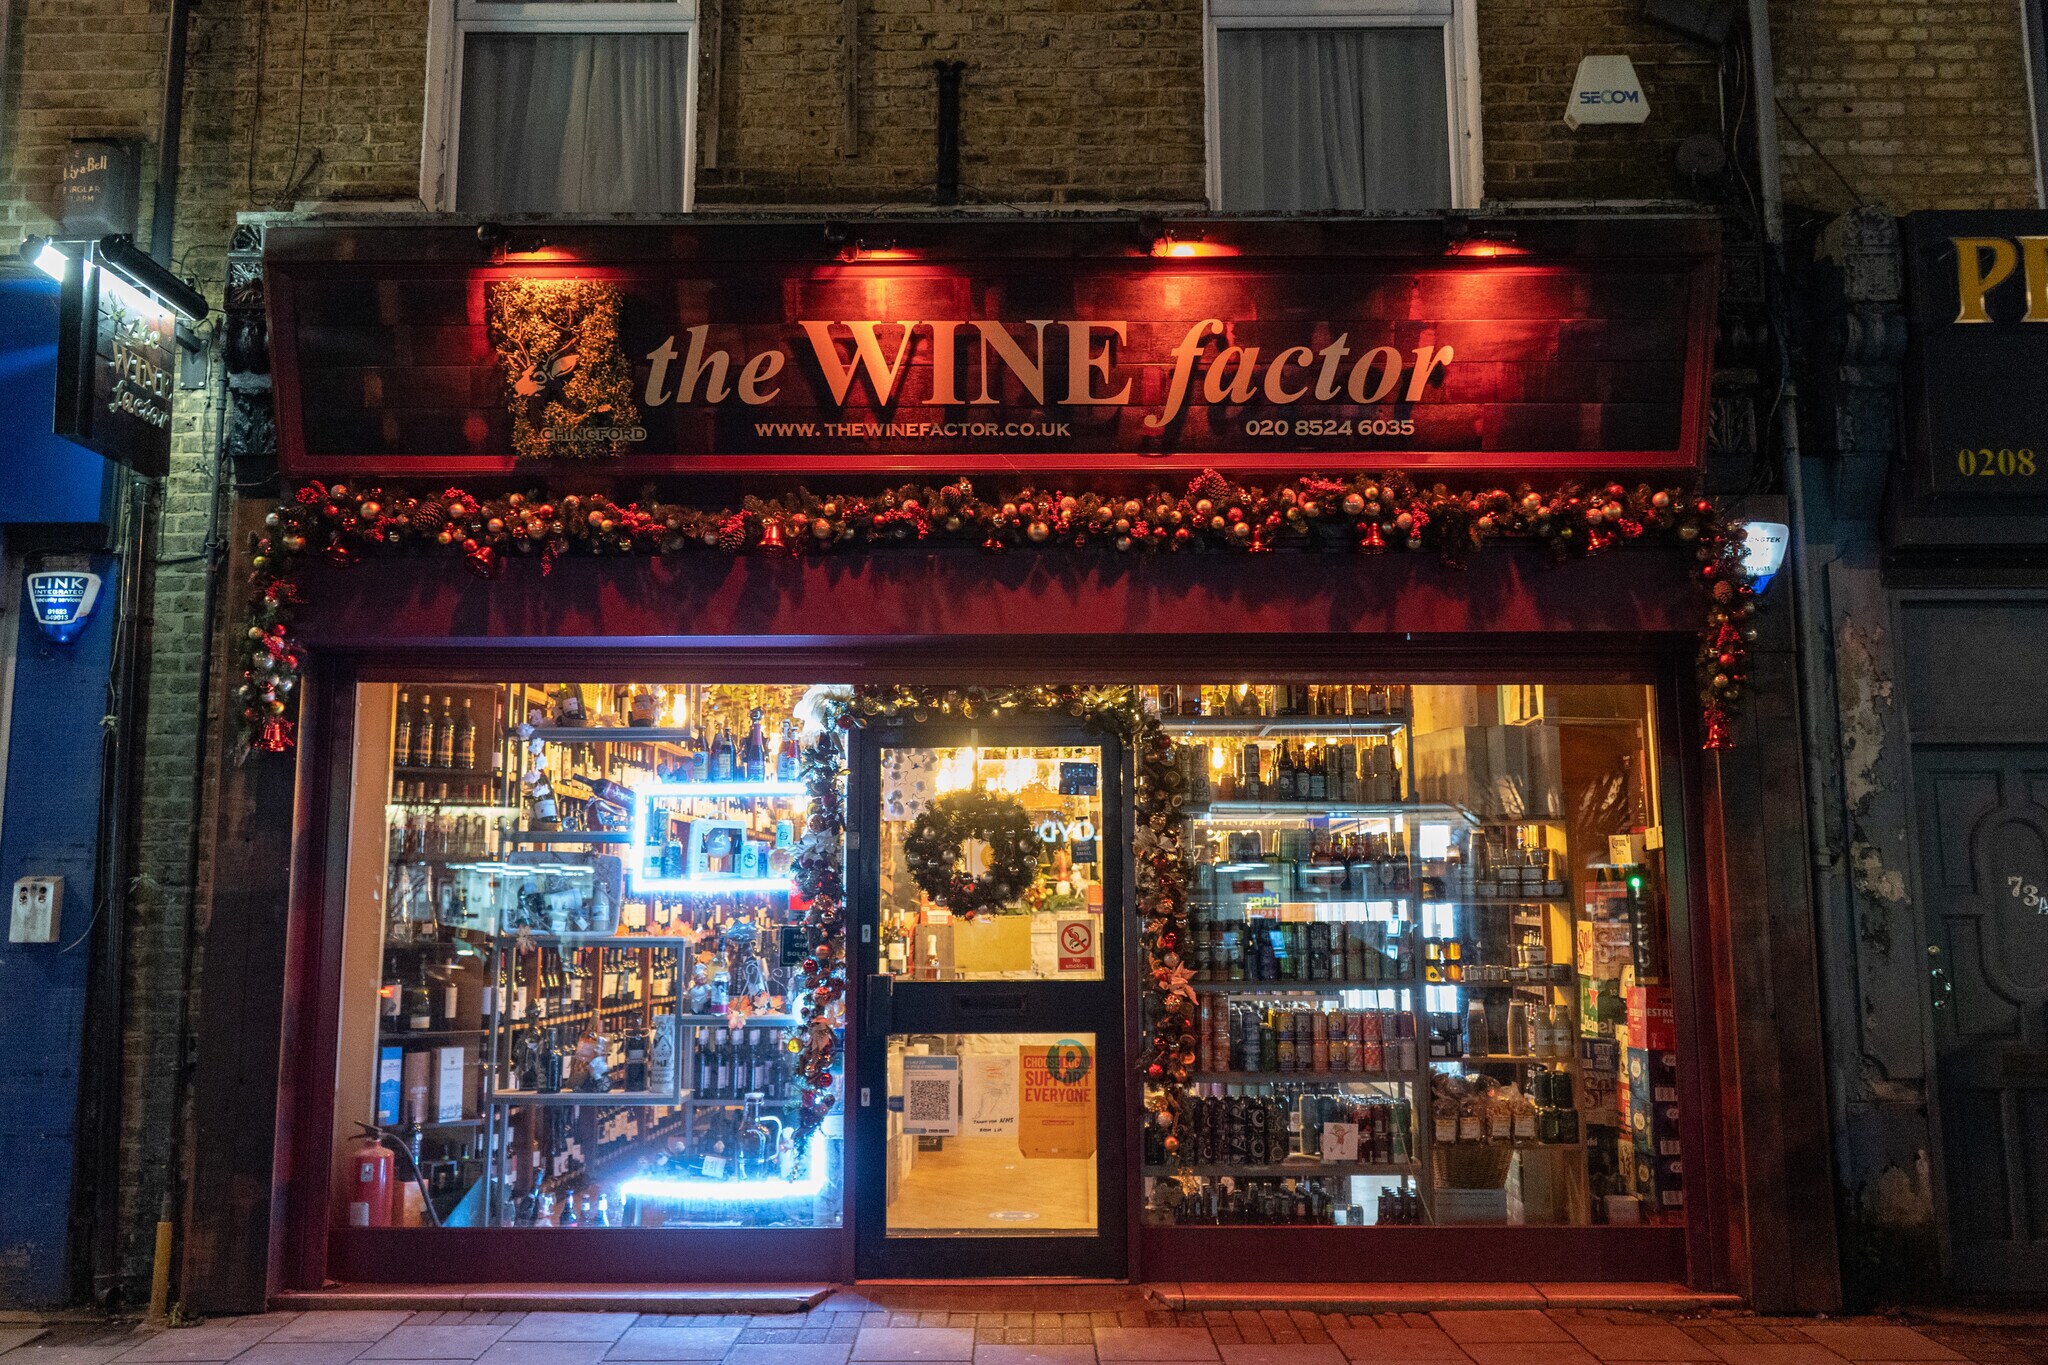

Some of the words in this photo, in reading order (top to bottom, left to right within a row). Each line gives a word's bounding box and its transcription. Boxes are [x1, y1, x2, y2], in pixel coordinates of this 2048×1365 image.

[1580, 89, 1639, 104] SECOM
[127, 317, 160, 349] the
[112, 340, 173, 402] WINE
[645, 324, 785, 407] the
[799, 319, 1132, 407] WINE
[1144, 318, 1454, 428] factor
[108, 380, 170, 429] factor
[540, 427, 647, 442] CHINGFORD
[1245, 420, 1289, 436] 020
[1295, 420, 1353, 436] 8524
[1358, 420, 1415, 436] 6035
[1957, 448, 2037, 476] 0208
[35, 578, 84, 589] LINK
[1063, 767, 1094, 777] OPEN
[1026, 1057, 1060, 1068] CHOOSE
[1062, 1057, 1092, 1068] LOCAL
[1025, 1070, 1091, 1086] SUPPORT
[1025, 1088, 1092, 1102] EVERYONE
